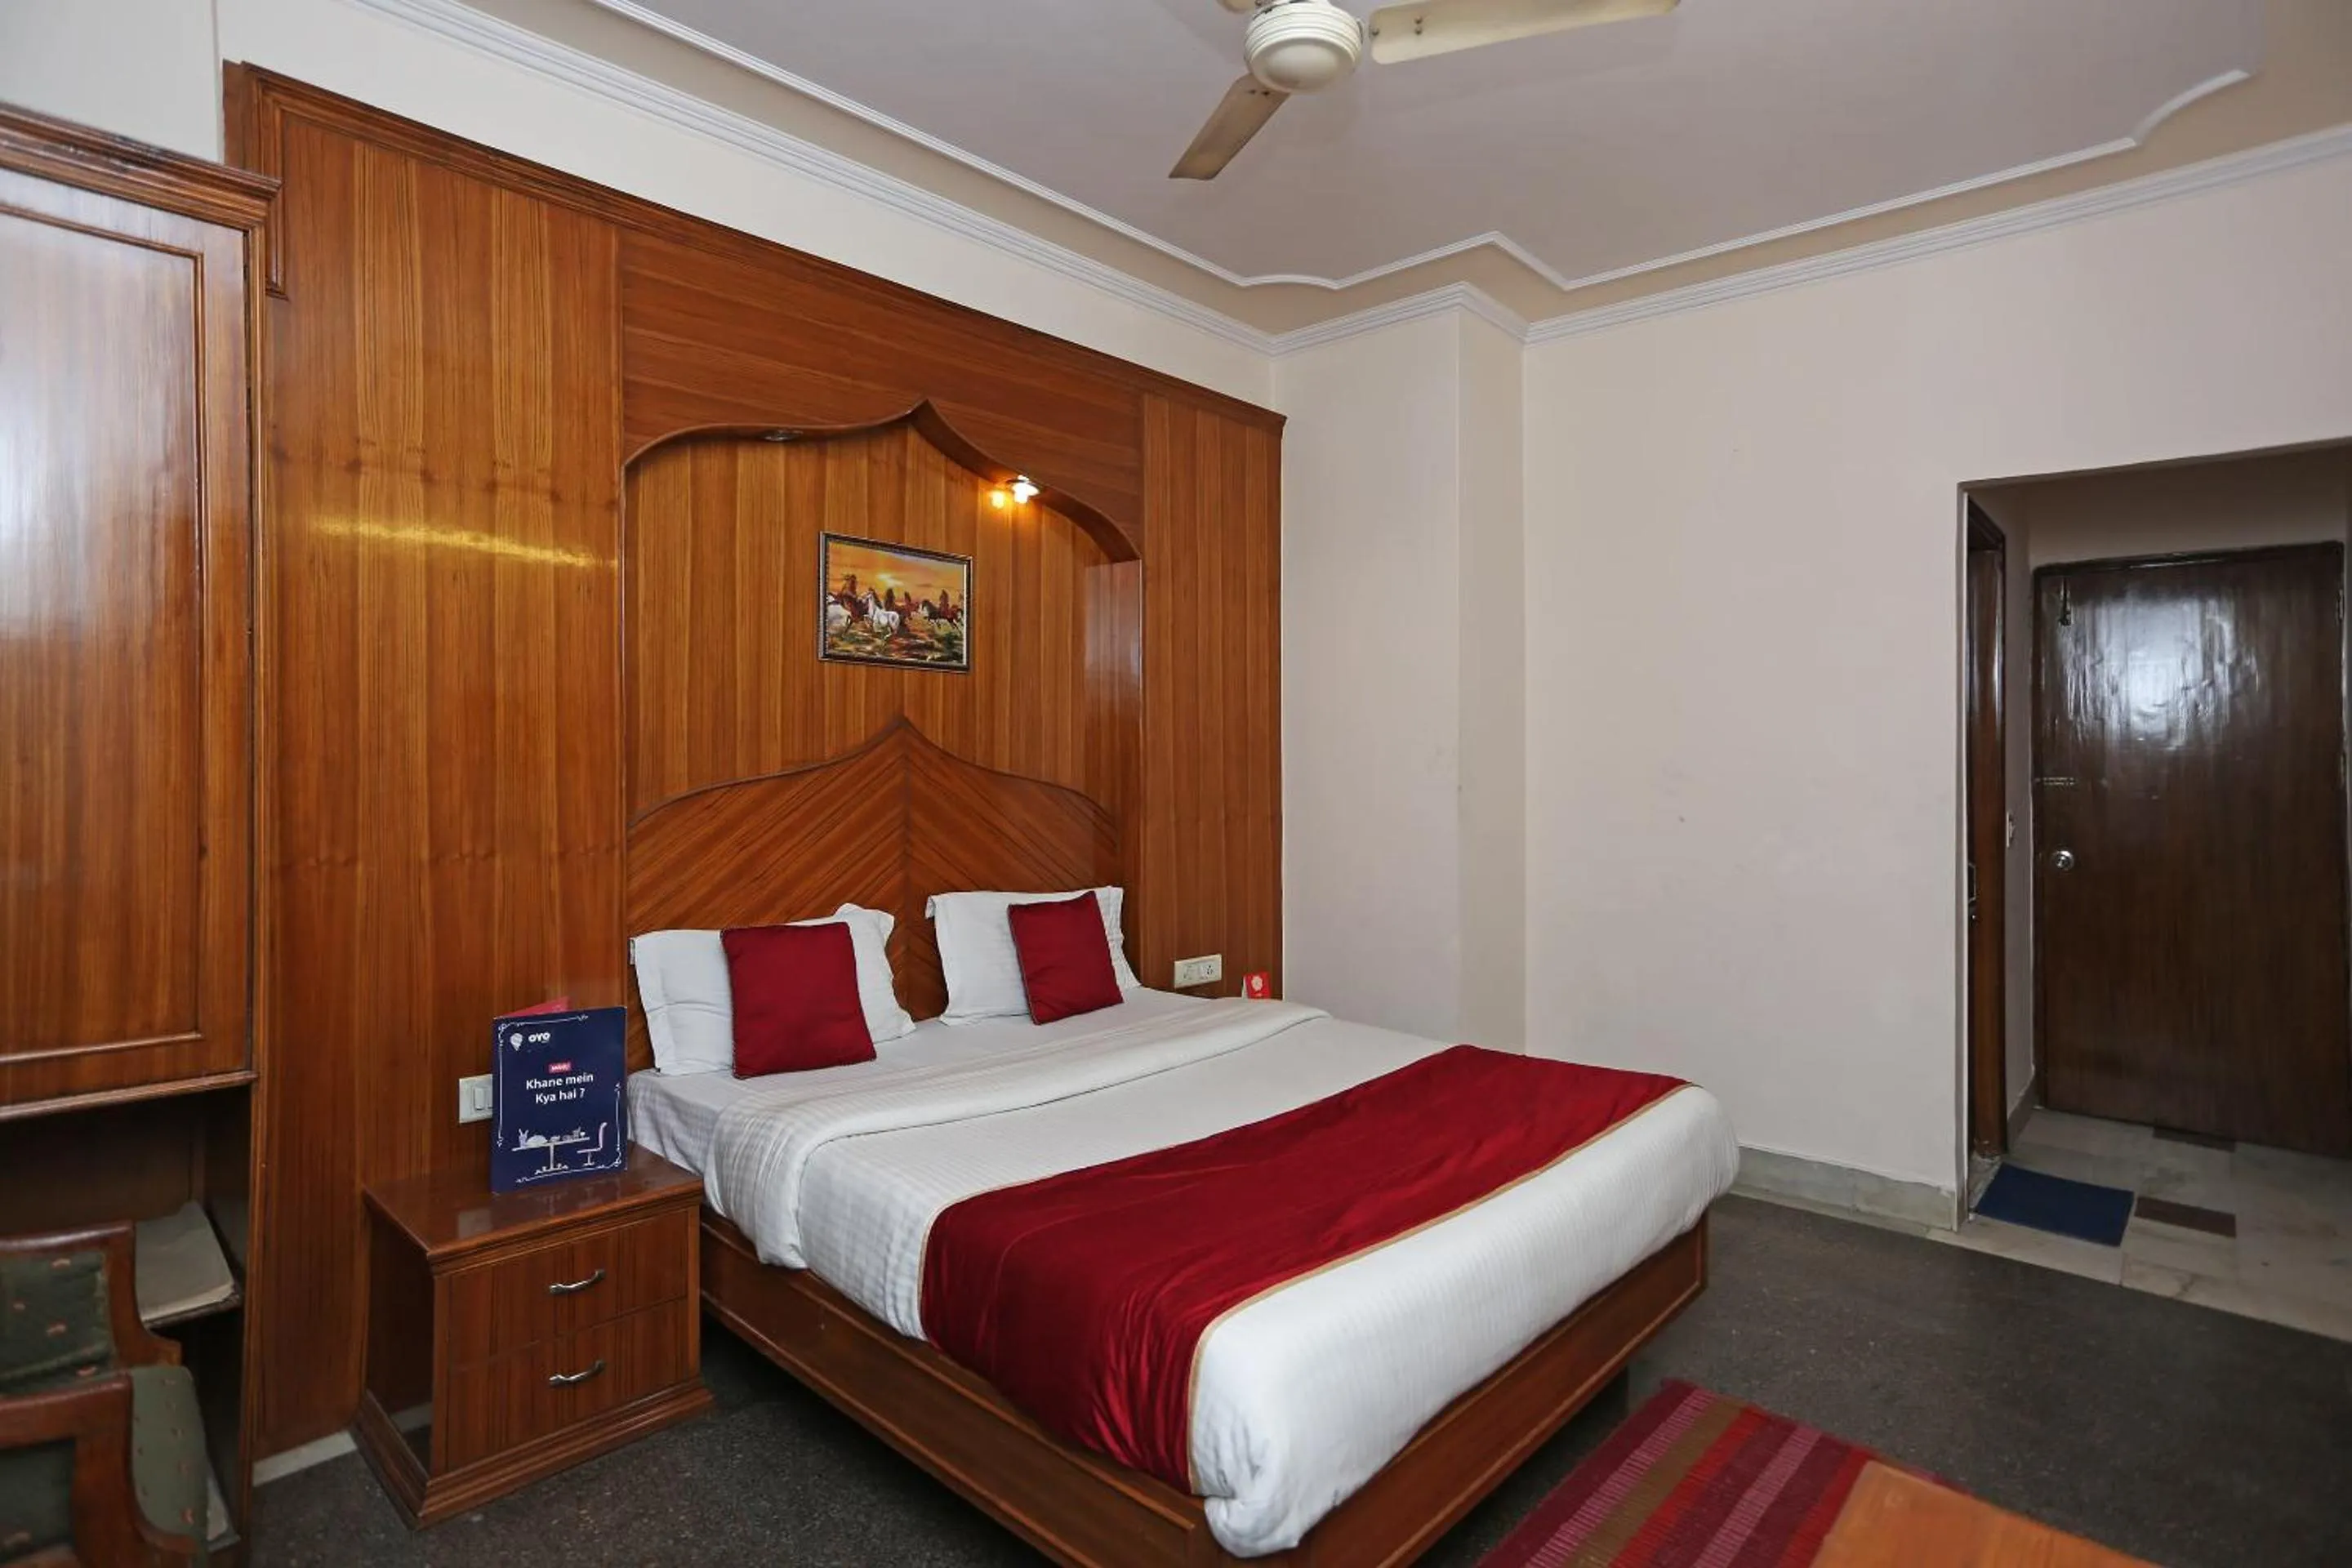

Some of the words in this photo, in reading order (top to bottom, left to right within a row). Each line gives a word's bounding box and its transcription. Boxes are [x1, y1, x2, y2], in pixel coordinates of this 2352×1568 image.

[526, 1078, 564, 1090] Khane
[565, 1072, 594, 1085] mein
[536, 1093, 556, 1105] Kya
[559, 1088, 577, 1100] hai
